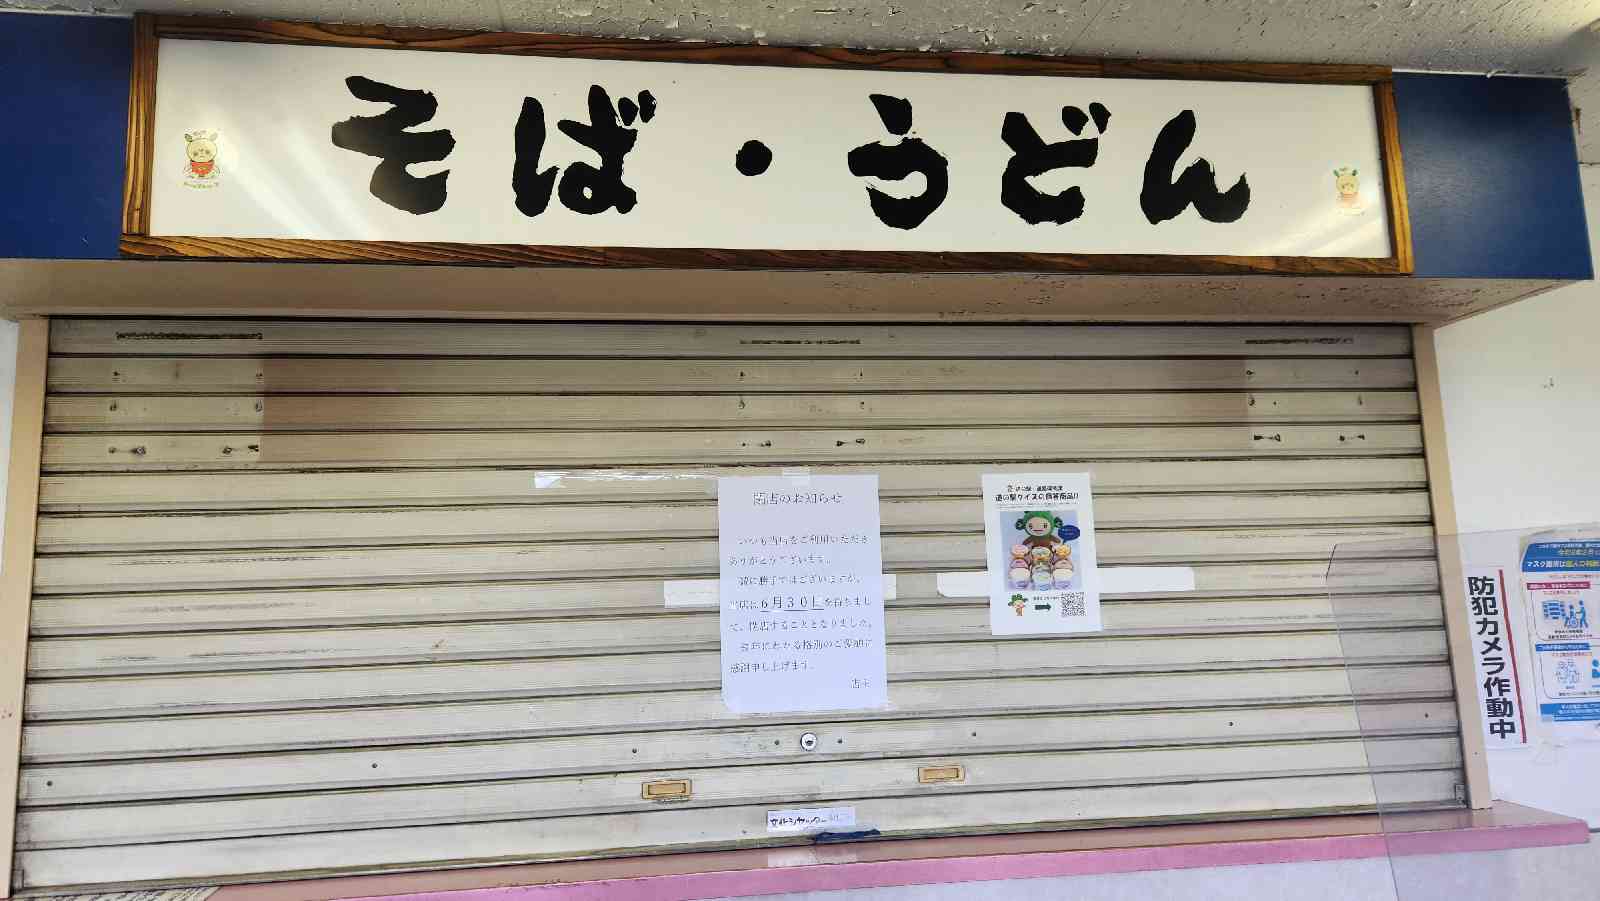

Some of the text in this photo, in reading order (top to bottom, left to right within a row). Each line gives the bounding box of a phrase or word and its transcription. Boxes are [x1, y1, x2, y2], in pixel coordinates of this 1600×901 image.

[332, 75, 1250, 230] そば・うどん
[1467, 576, 1516, 740] 防犯カメラ作動中
